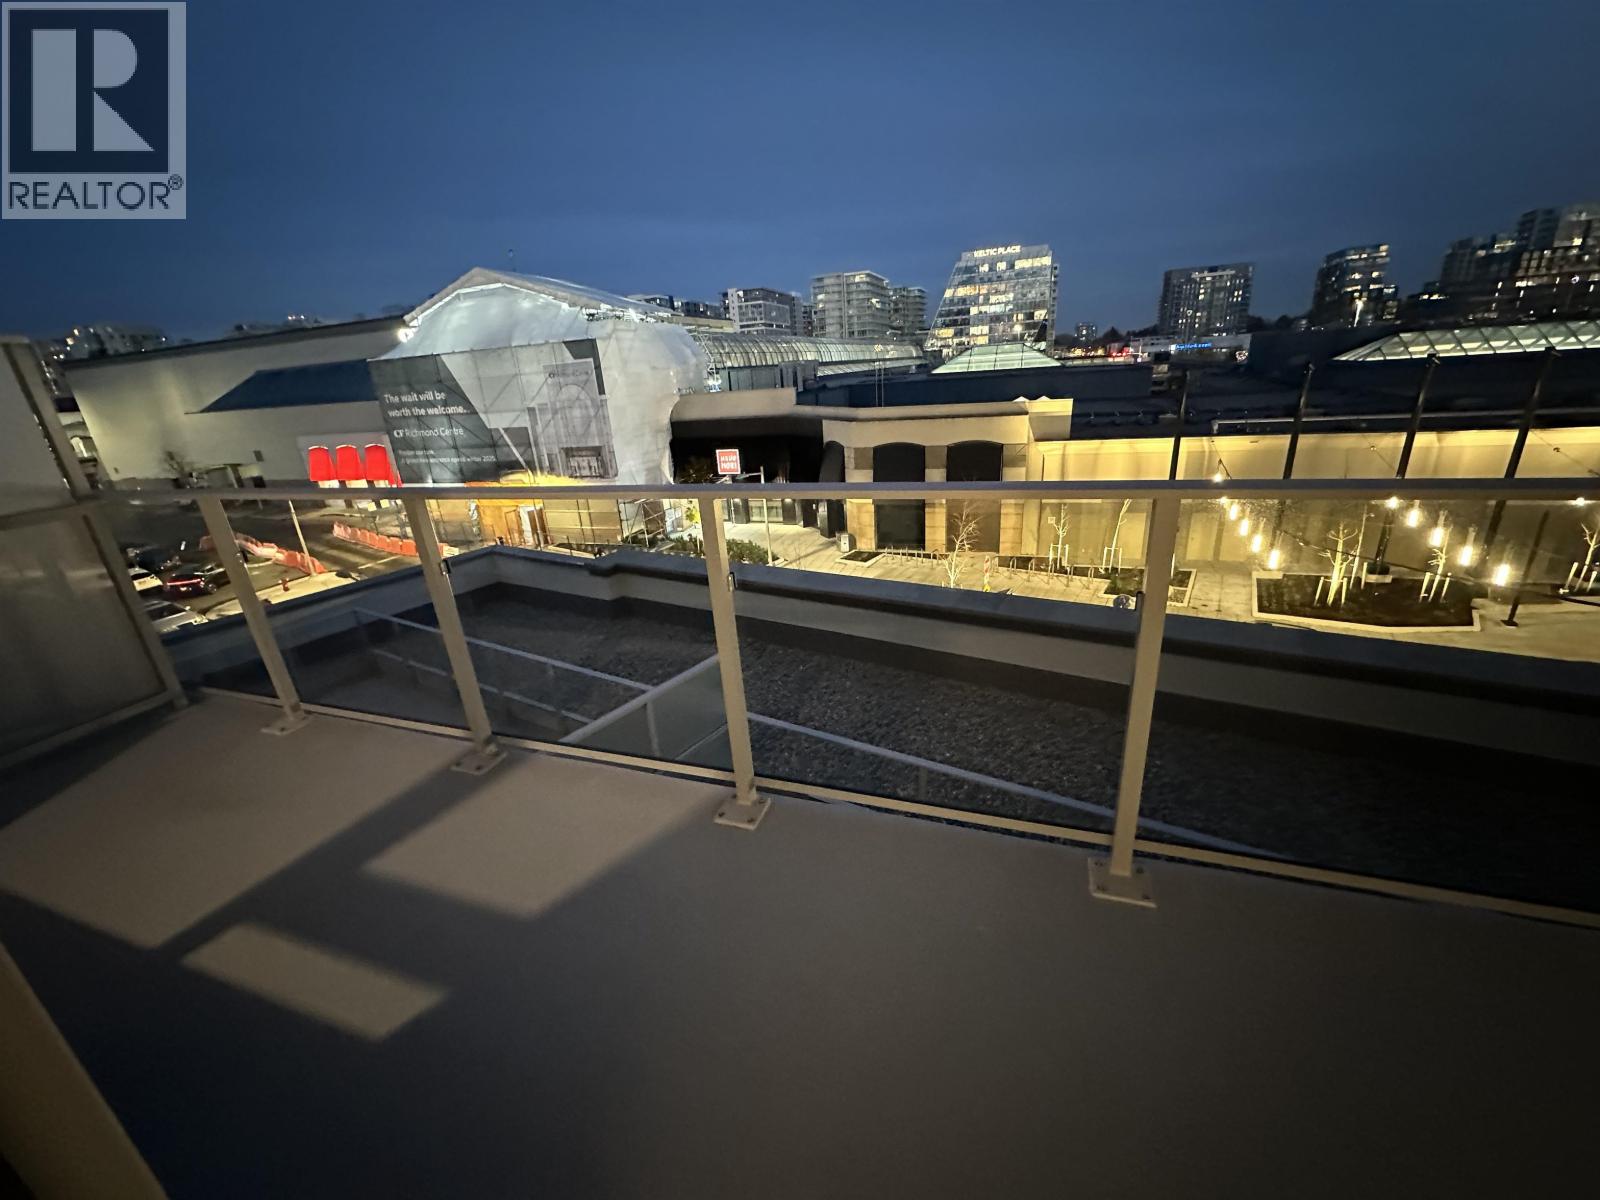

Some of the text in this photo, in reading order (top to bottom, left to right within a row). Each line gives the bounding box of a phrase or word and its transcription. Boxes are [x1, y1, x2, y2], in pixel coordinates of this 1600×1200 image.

[998, 245, 1021, 254] PLACE
[384, 390, 446, 403] The wait will be
[388, 408, 411, 417] worth
[412, 407, 425, 416] the
